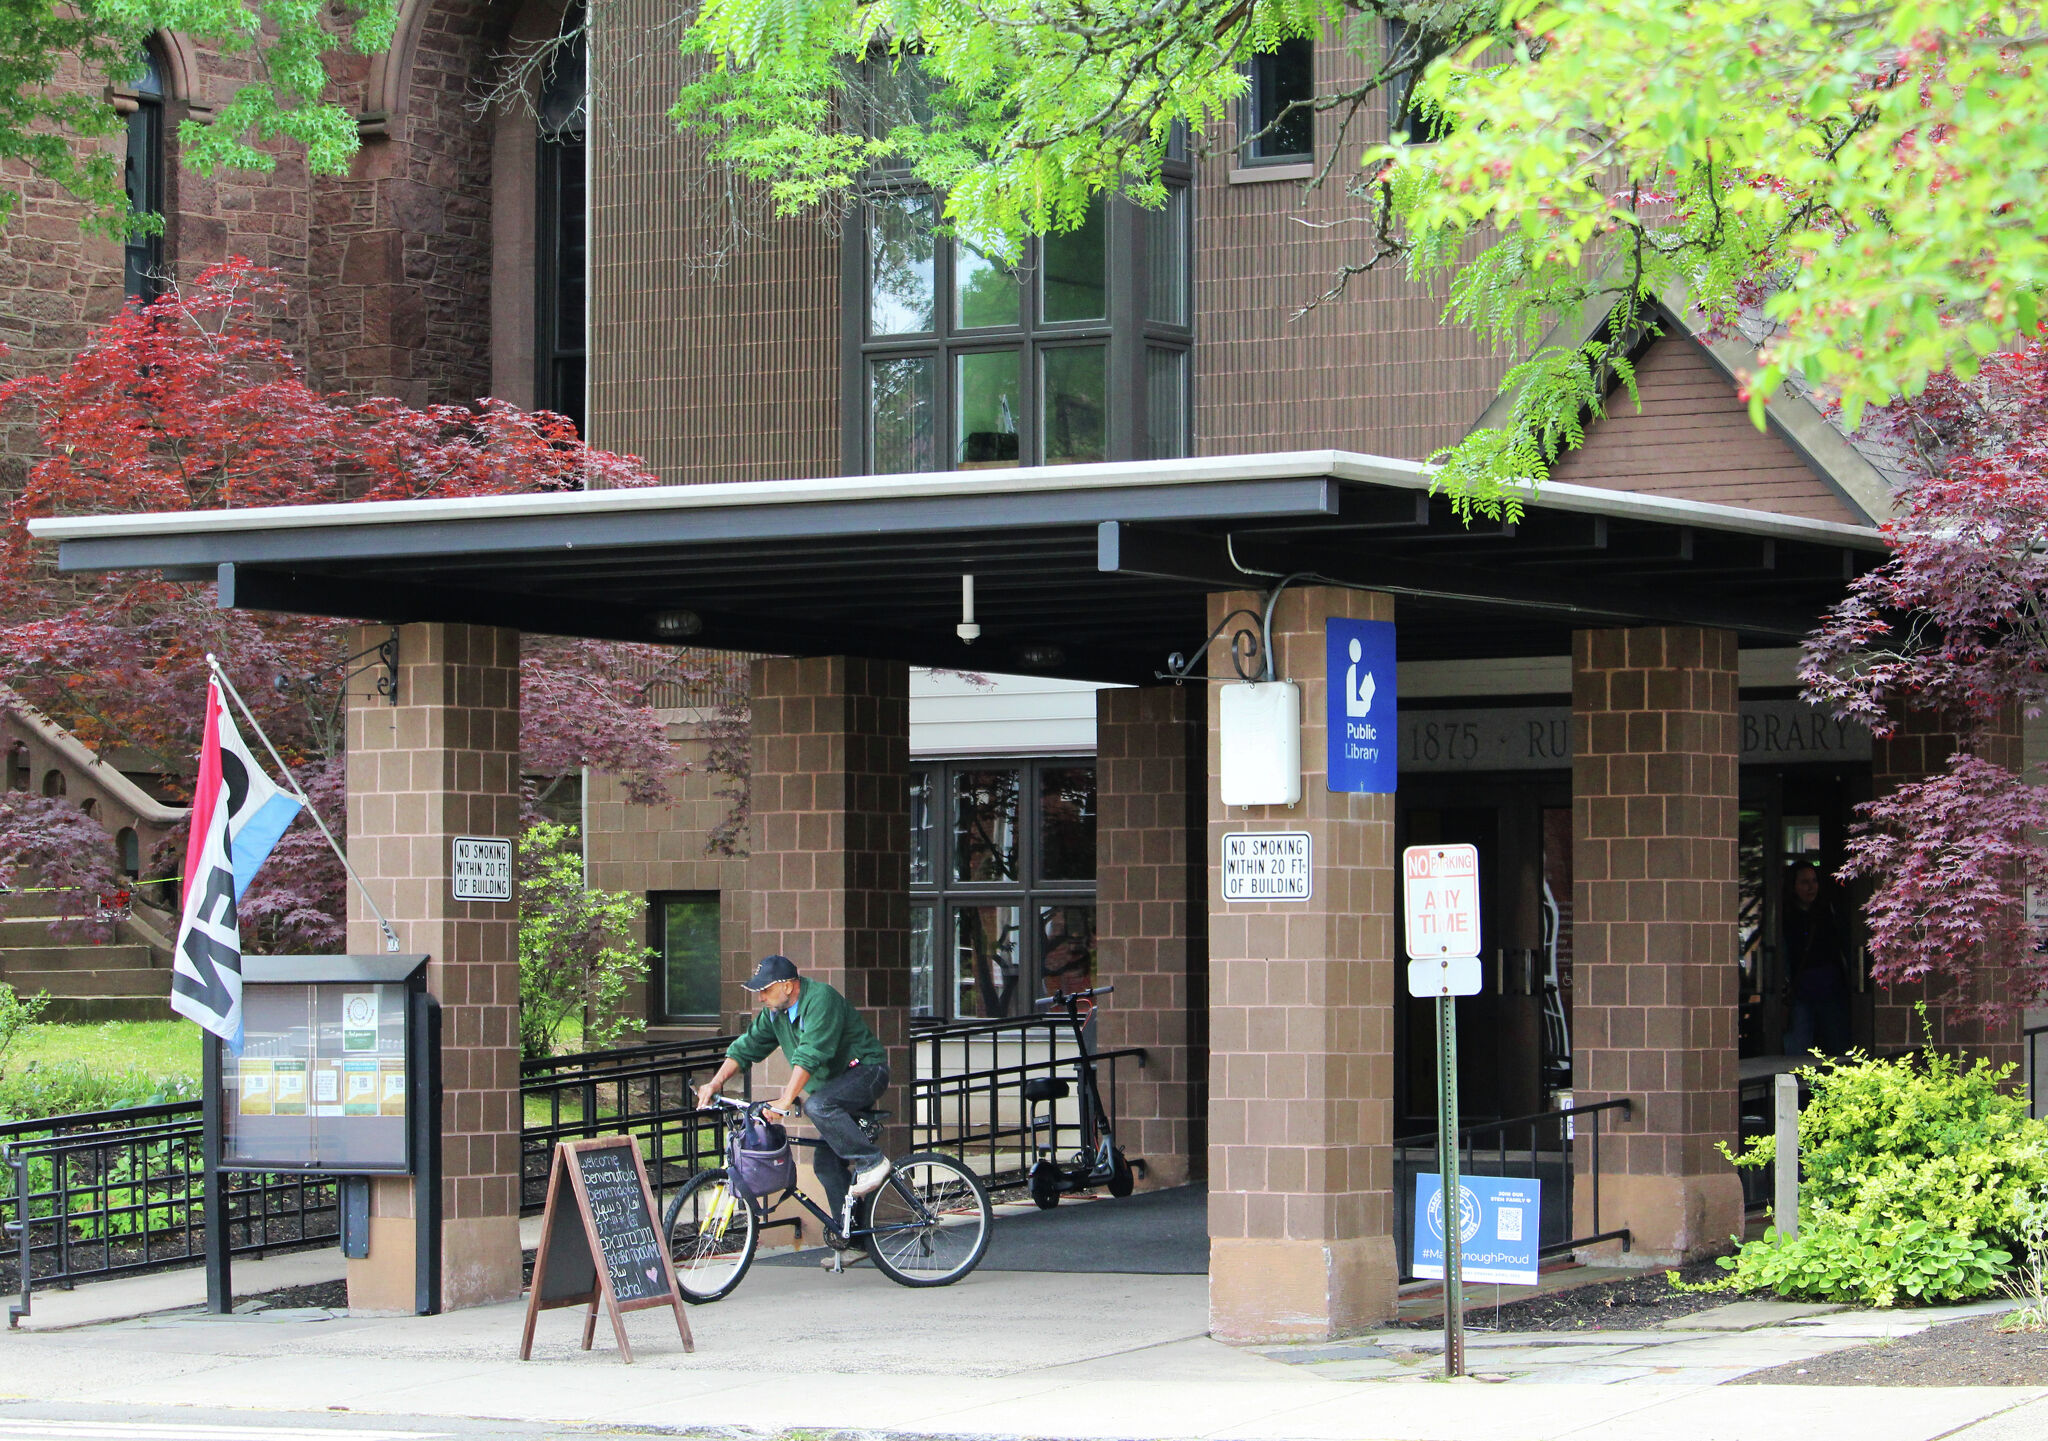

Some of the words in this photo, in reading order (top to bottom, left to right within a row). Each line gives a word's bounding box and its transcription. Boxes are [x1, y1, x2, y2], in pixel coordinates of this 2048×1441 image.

[1347, 722, 1377, 741] Public
[1411, 721, 1478, 760] 1875
[1741, 712, 1849, 752] BRARY
[1345, 743, 1379, 764] Library
[459, 844, 469, 858] NO
[473, 844, 506, 860] SMOKING
[1231, 840, 1246, 855] NO
[1252, 839, 1303, 855] SMOKING
[456, 861, 482, 876] WITHIN
[485, 862, 495, 877] 20
[1227, 859, 1265, 875] WITHIN
[1270, 859, 1285, 874] 20
[1408, 855, 1429, 877] NO
[458, 878, 468, 893] OF
[472, 879, 507, 895] BUILDING
[1230, 878, 1244, 894] OF
[1251, 878, 1304, 894] BUILDING
[580, 1154, 620, 1169] welcome
